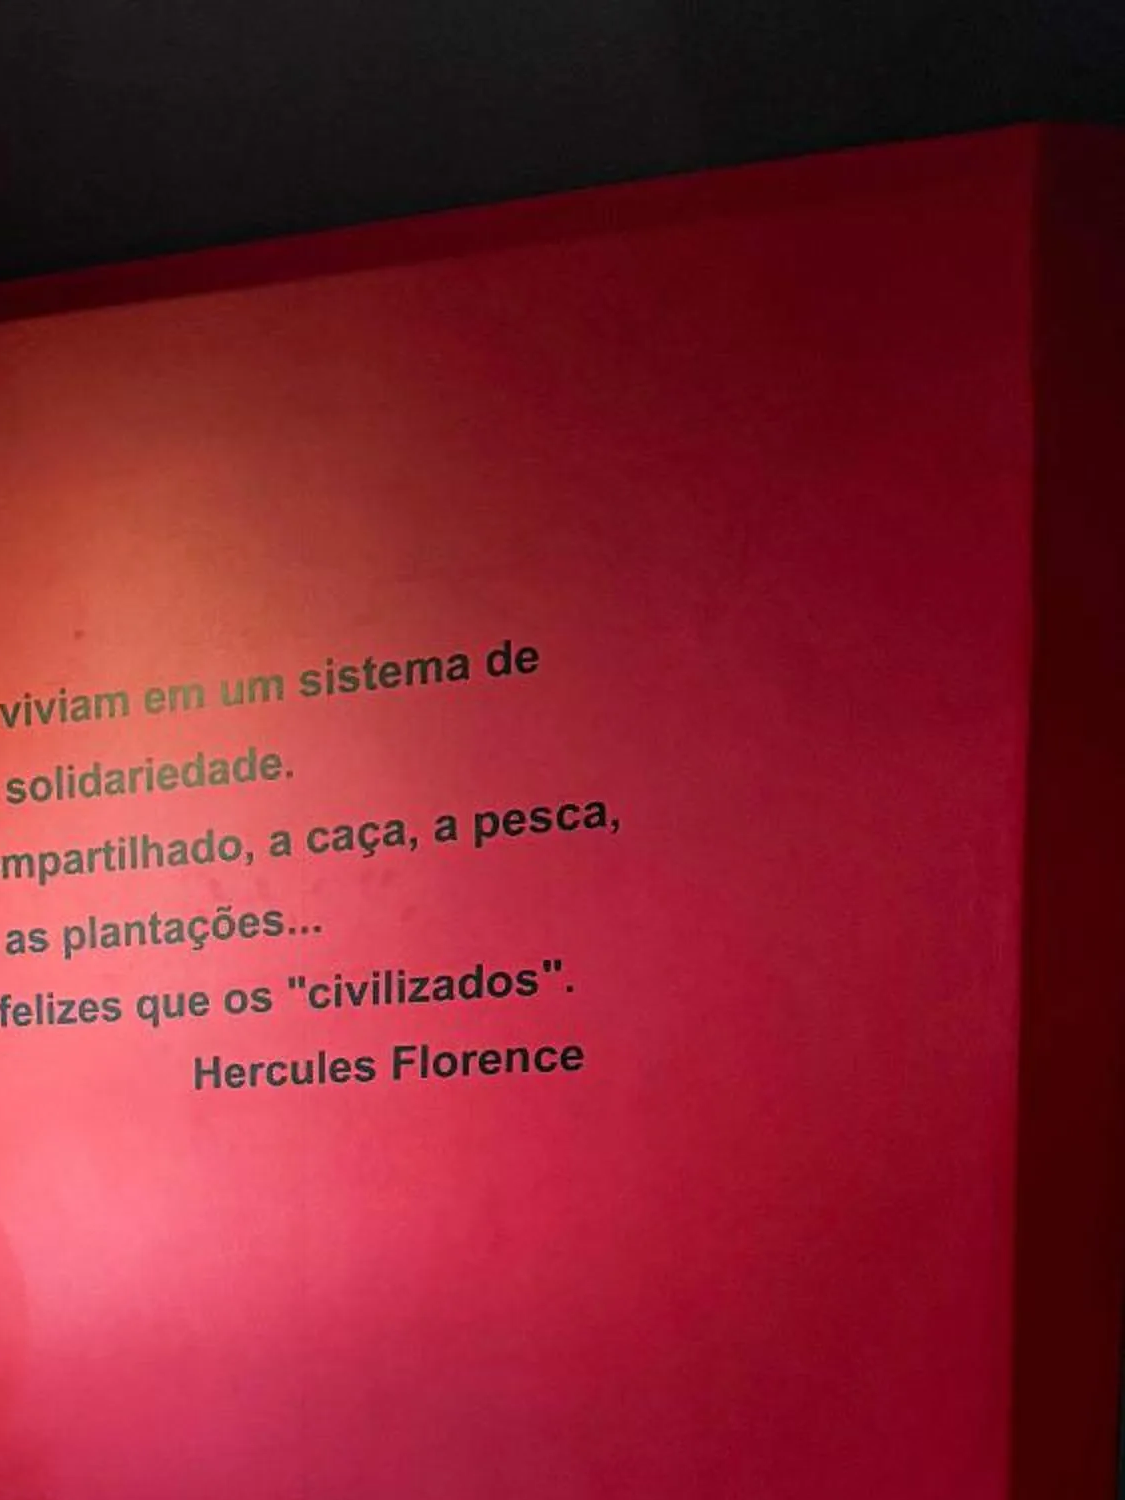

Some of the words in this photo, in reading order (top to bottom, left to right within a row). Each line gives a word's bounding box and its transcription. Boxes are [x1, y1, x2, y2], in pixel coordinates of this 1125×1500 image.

[144, 685, 205, 714] em
[221, 675, 284, 706] um
[299, 653, 470, 698] sistema
[486, 639, 540, 678] de
[5, 746, 294, 806] solidariedade.
[268, 830, 292, 858] a
[306, 819, 418, 859] caça,
[434, 814, 458, 843] a
[473, 801, 620, 848] pesca,
[4, 927, 51, 957] as
[62, 905, 322, 961] plantações...
[135, 991, 211, 1029] que
[223, 986, 274, 1016] os
[287, 958, 574, 1012] "civilizados".
[193, 1049, 377, 1091] Hercules
[391, 1043, 585, 1082] Florence
